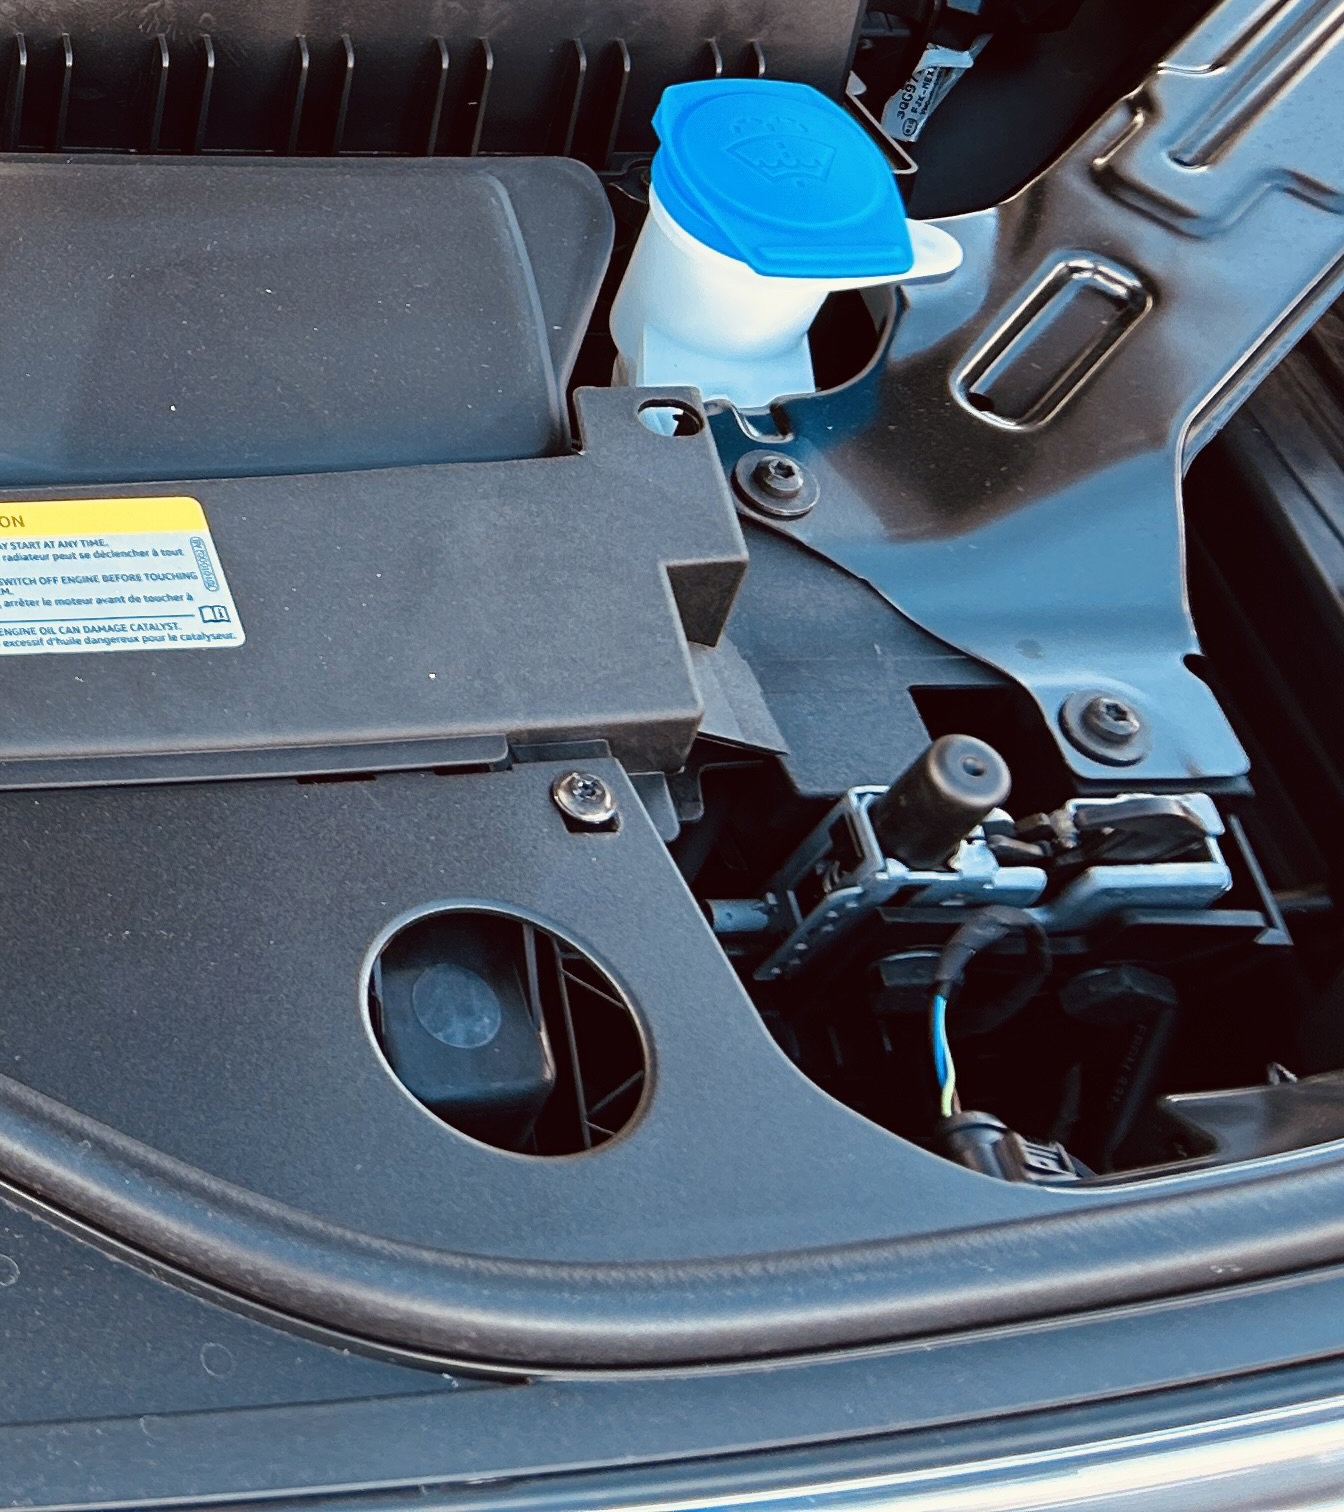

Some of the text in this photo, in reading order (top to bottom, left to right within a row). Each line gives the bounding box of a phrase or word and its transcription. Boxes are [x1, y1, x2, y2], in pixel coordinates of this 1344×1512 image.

[10, 541, 41, 550] START
[44, 541, 55, 549] AT
[58, 540, 77, 548] ANY
[80, 539, 108, 547] TIME.
[2, 553, 49, 561] radiateur
[52, 552, 77, 562] peut
[93, 549, 149, 558] déclencher
[152, 548, 159, 557] à
[39, 577, 58, 585] OFF
[61, 575, 100, 584] ENGINE
[102, 574, 142, 582] BEFORE
[144, 572, 198, 581] TOUCHING
[42, 598, 52, 606] le
[54, 598, 93, 606] moteur
[96, 596, 126, 604] avant
[128, 594, 141, 603] de
[143, 594, 183, 602] toucher
[39, 627, 57, 635] OIL
[59, 626, 81, 634] CAN
[83, 624, 128, 633] DAMAGE
[130, 622, 182, 631] CATALYST.
[3, 637, 44, 647] excessif
[46, 637, 81, 646] d'huile
[84, 636, 140, 646] dangereux
[142, 636, 165, 644] pour
